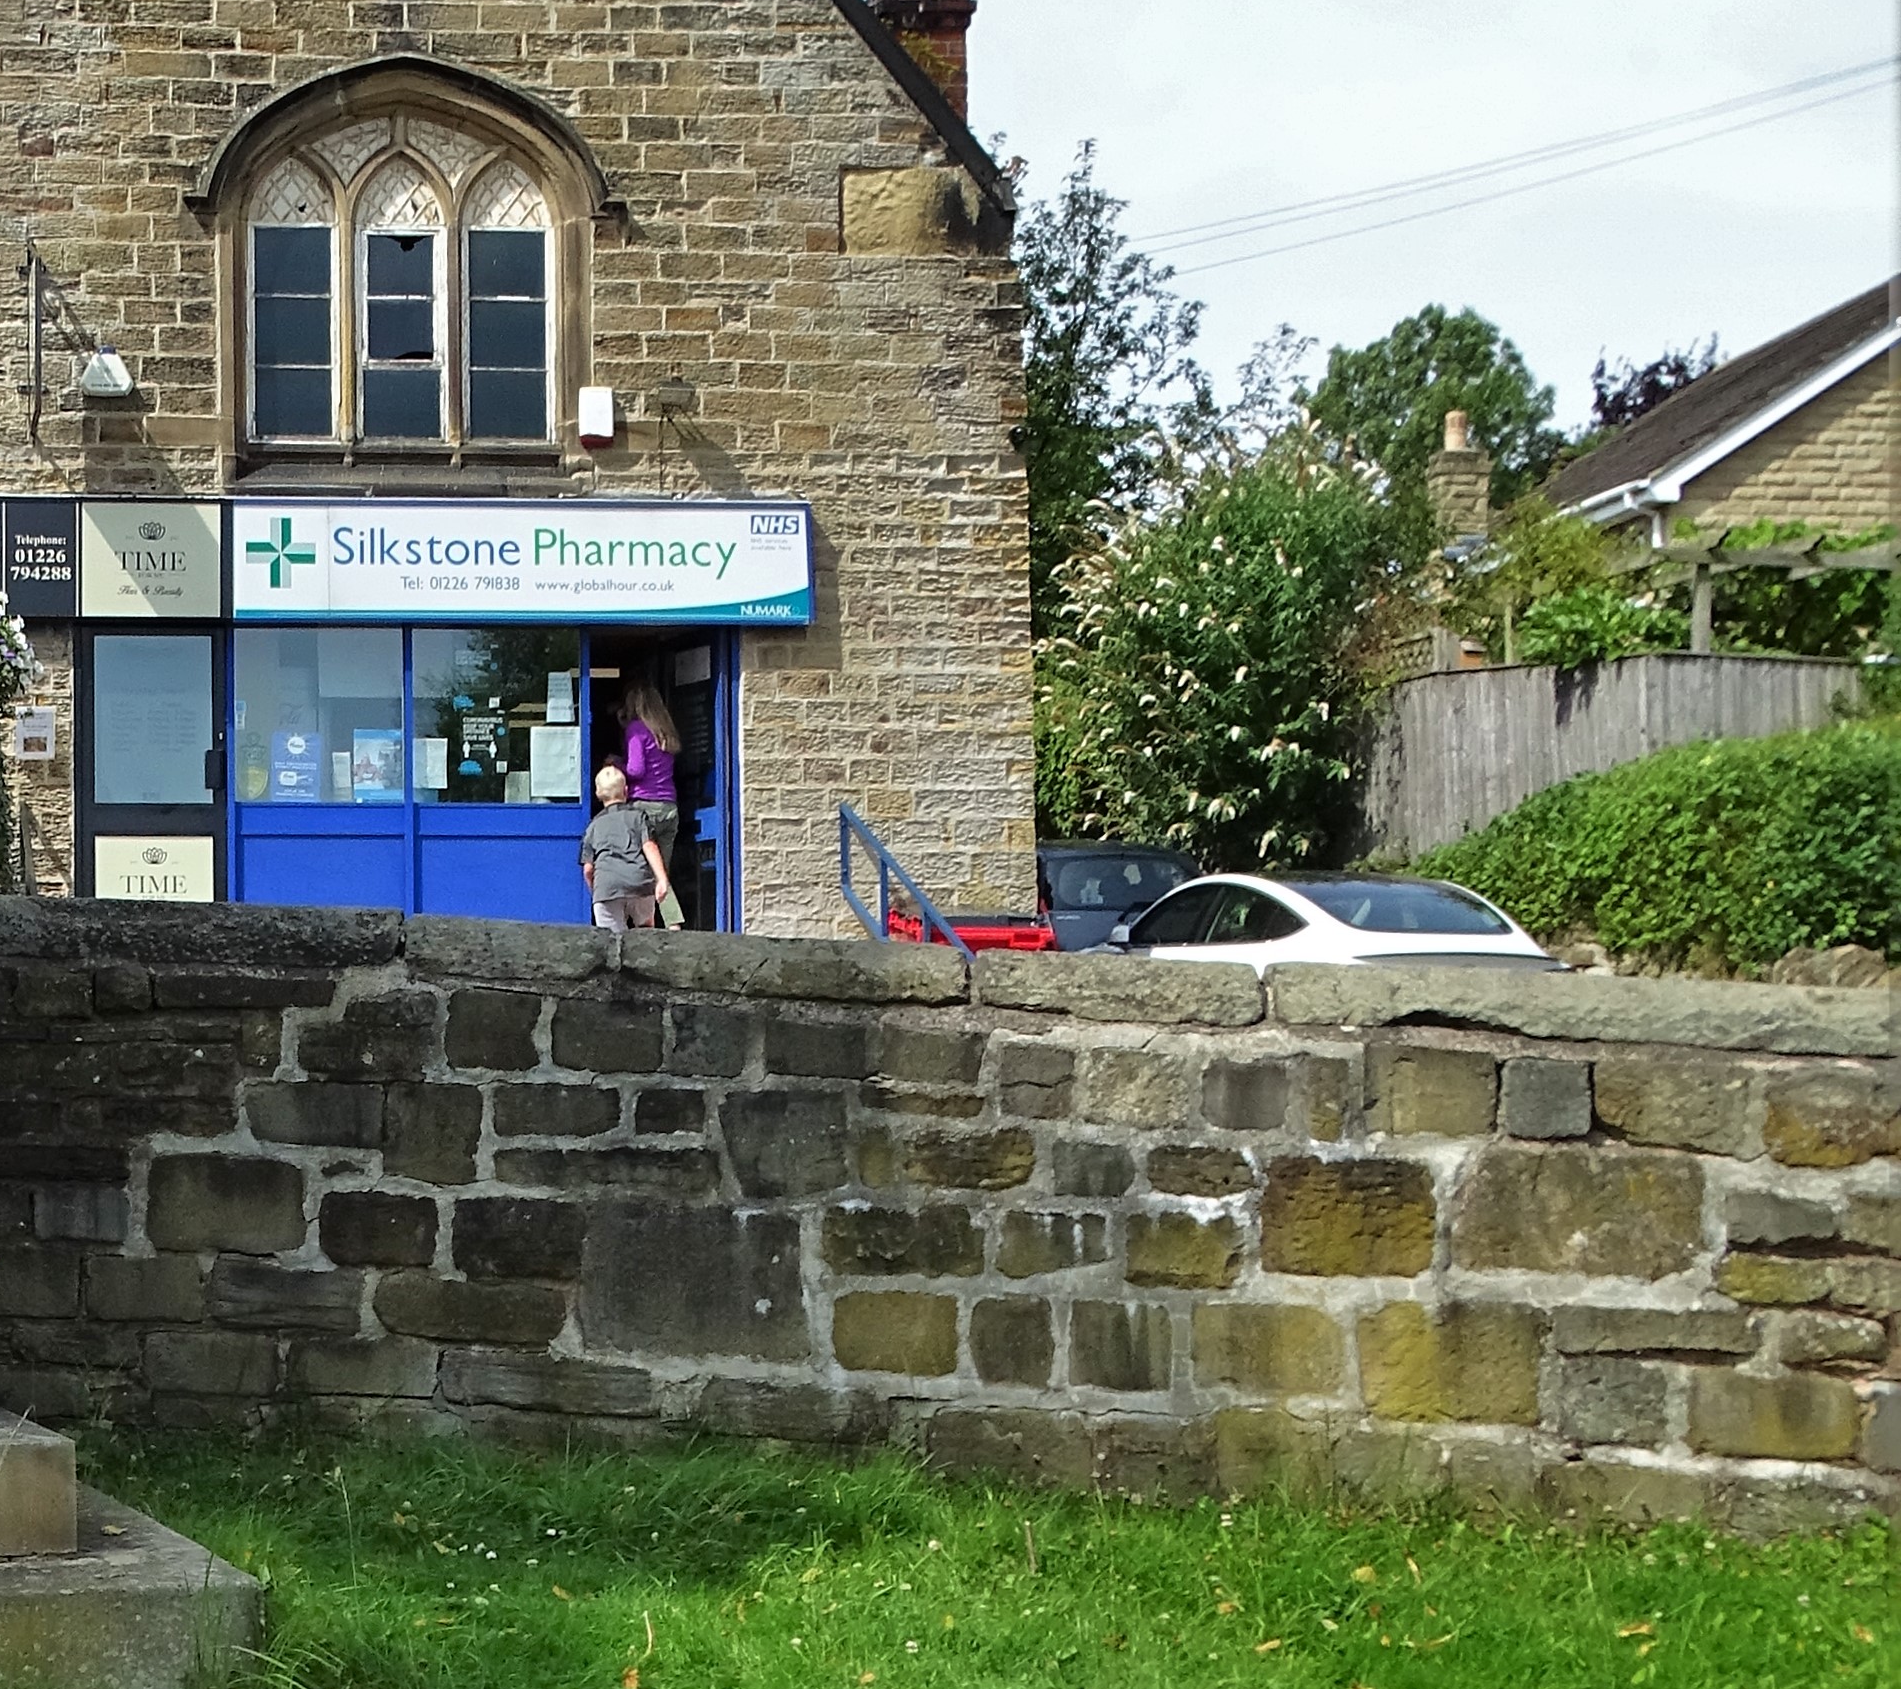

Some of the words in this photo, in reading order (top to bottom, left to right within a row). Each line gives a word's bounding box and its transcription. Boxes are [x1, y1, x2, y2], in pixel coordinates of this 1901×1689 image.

[752, 516, 798, 533] NHS
[15, 535, 66, 546] Telephone:
[14, 549, 67, 563] 01226
[115, 551, 186, 572] TIME
[333, 527, 521, 565] Silkstone
[534, 528, 737, 580] Pharmacy
[10, 566, 72, 581] 794288
[400, 576, 424, 590] Tel:
[429, 576, 468, 590] 01226
[474, 576, 521, 590] 791838
[534, 579, 674, 594] www.globalhour.co.uk
[740, 604, 792, 617] NUMARK
[119, 874, 188, 894] TIME
